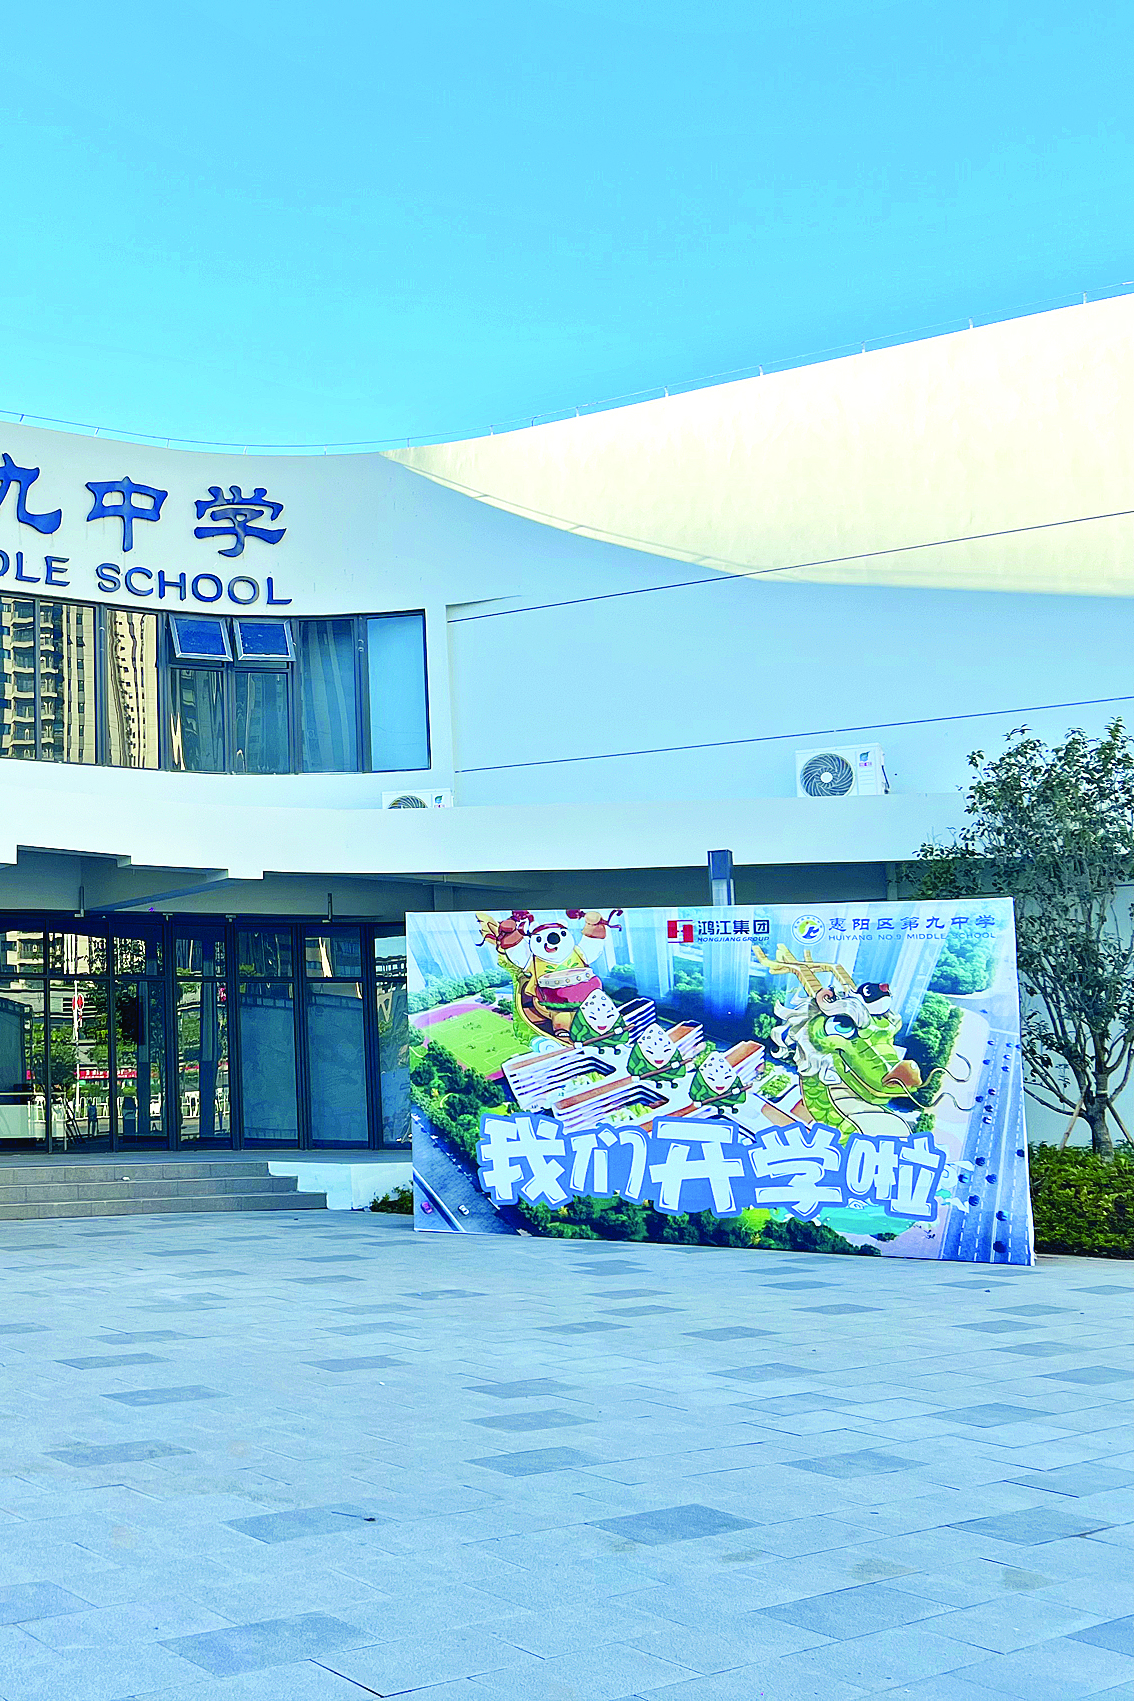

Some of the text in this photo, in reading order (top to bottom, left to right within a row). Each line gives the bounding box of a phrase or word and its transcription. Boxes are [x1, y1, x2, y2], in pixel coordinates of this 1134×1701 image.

[95, 562, 293, 605] SCHOOL
[697, 919, 770, 936] 鸿江集团
[828, 914, 996, 932] 惠阳区第九中学
[481, 1116, 938, 1217] 我们开学啦
